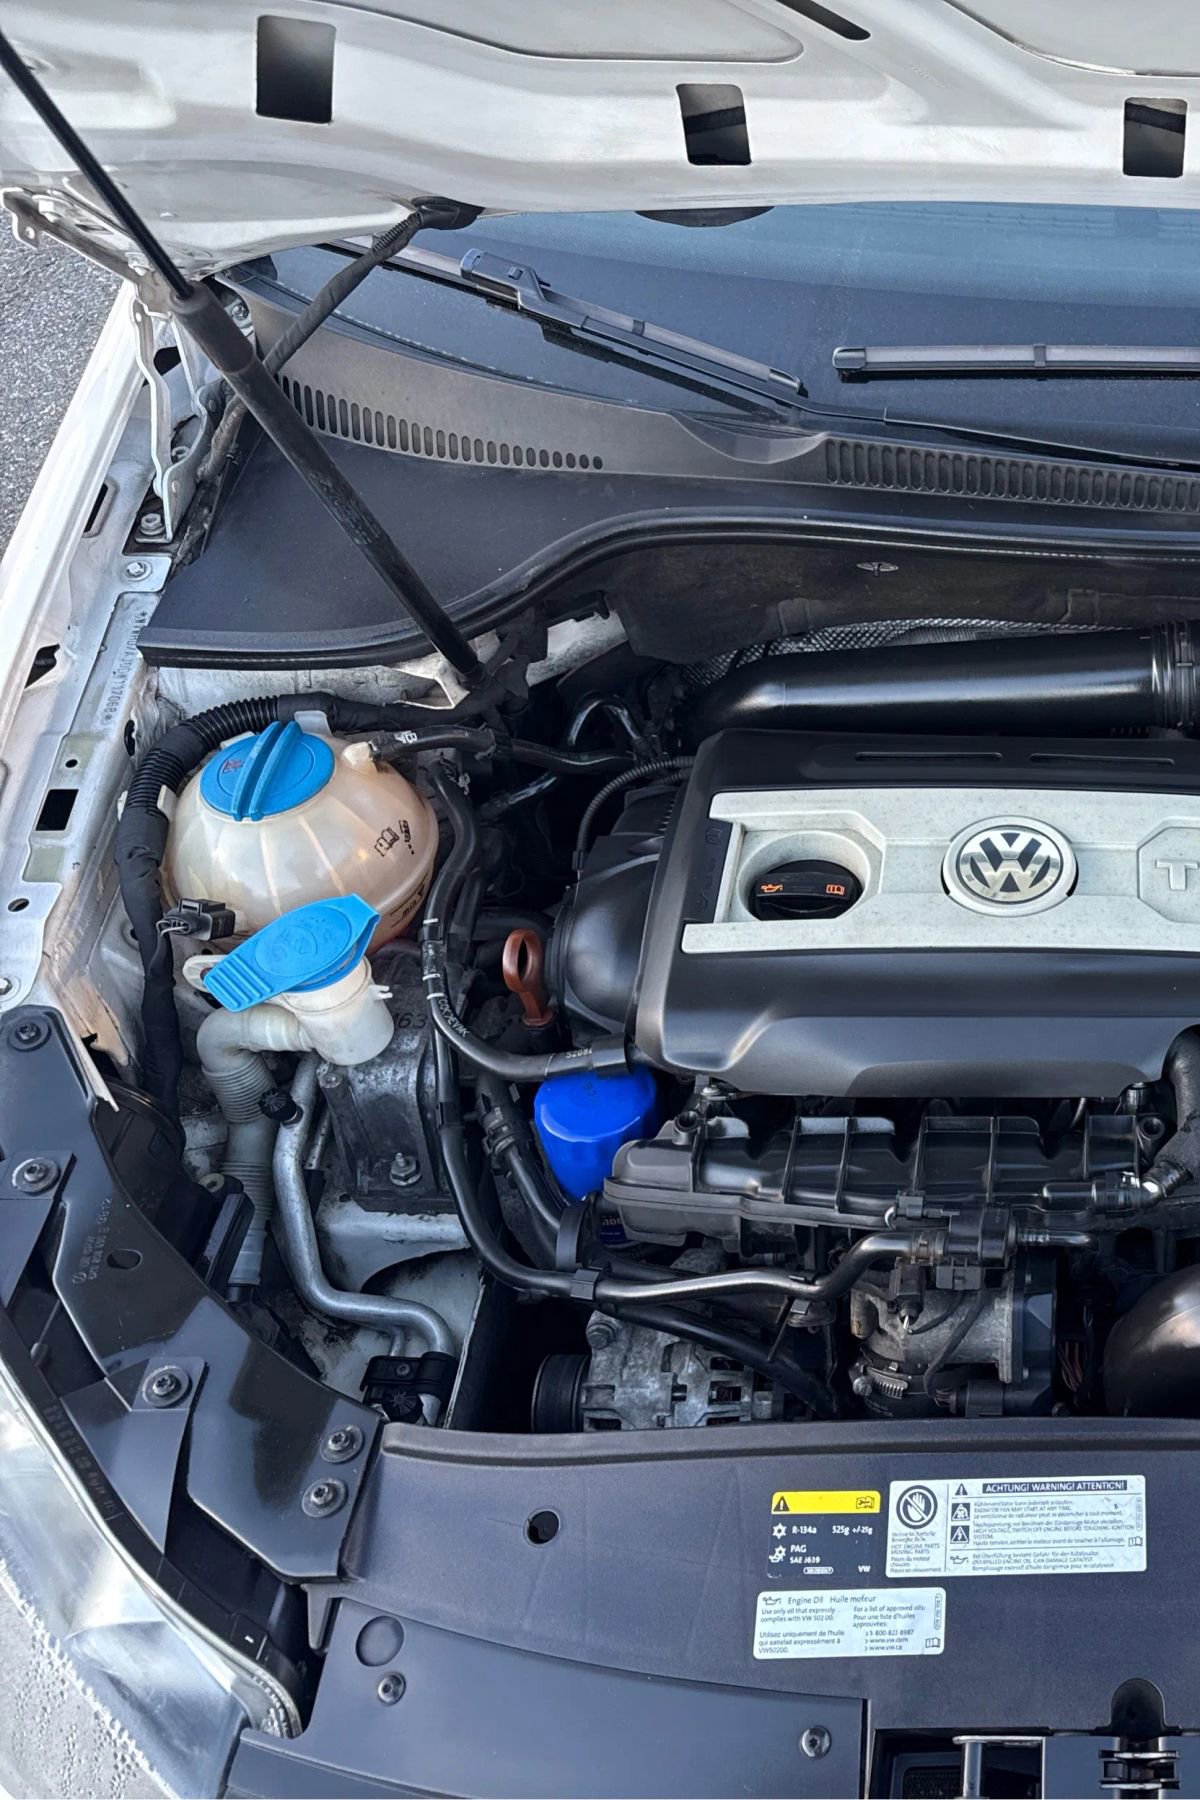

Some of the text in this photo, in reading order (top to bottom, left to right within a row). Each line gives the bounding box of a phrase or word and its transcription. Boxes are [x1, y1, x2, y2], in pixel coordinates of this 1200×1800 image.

[402, 899, 417, 918] min
[985, 1483, 1030, 1492] ACHTUNG!
[1032, 1482, 1074, 1491] WARNING!
[792, 1525, 817, 1534] R-134a
[832, 1525, 850, 1535] 525g
[790, 1544, 807, 1553] PAG
[789, 1556, 802, 1564] SAE
[788, 1596, 812, 1606] Engine
[830, 1595, 848, 1603] Huile
[886, 1604, 912, 1613] approved
